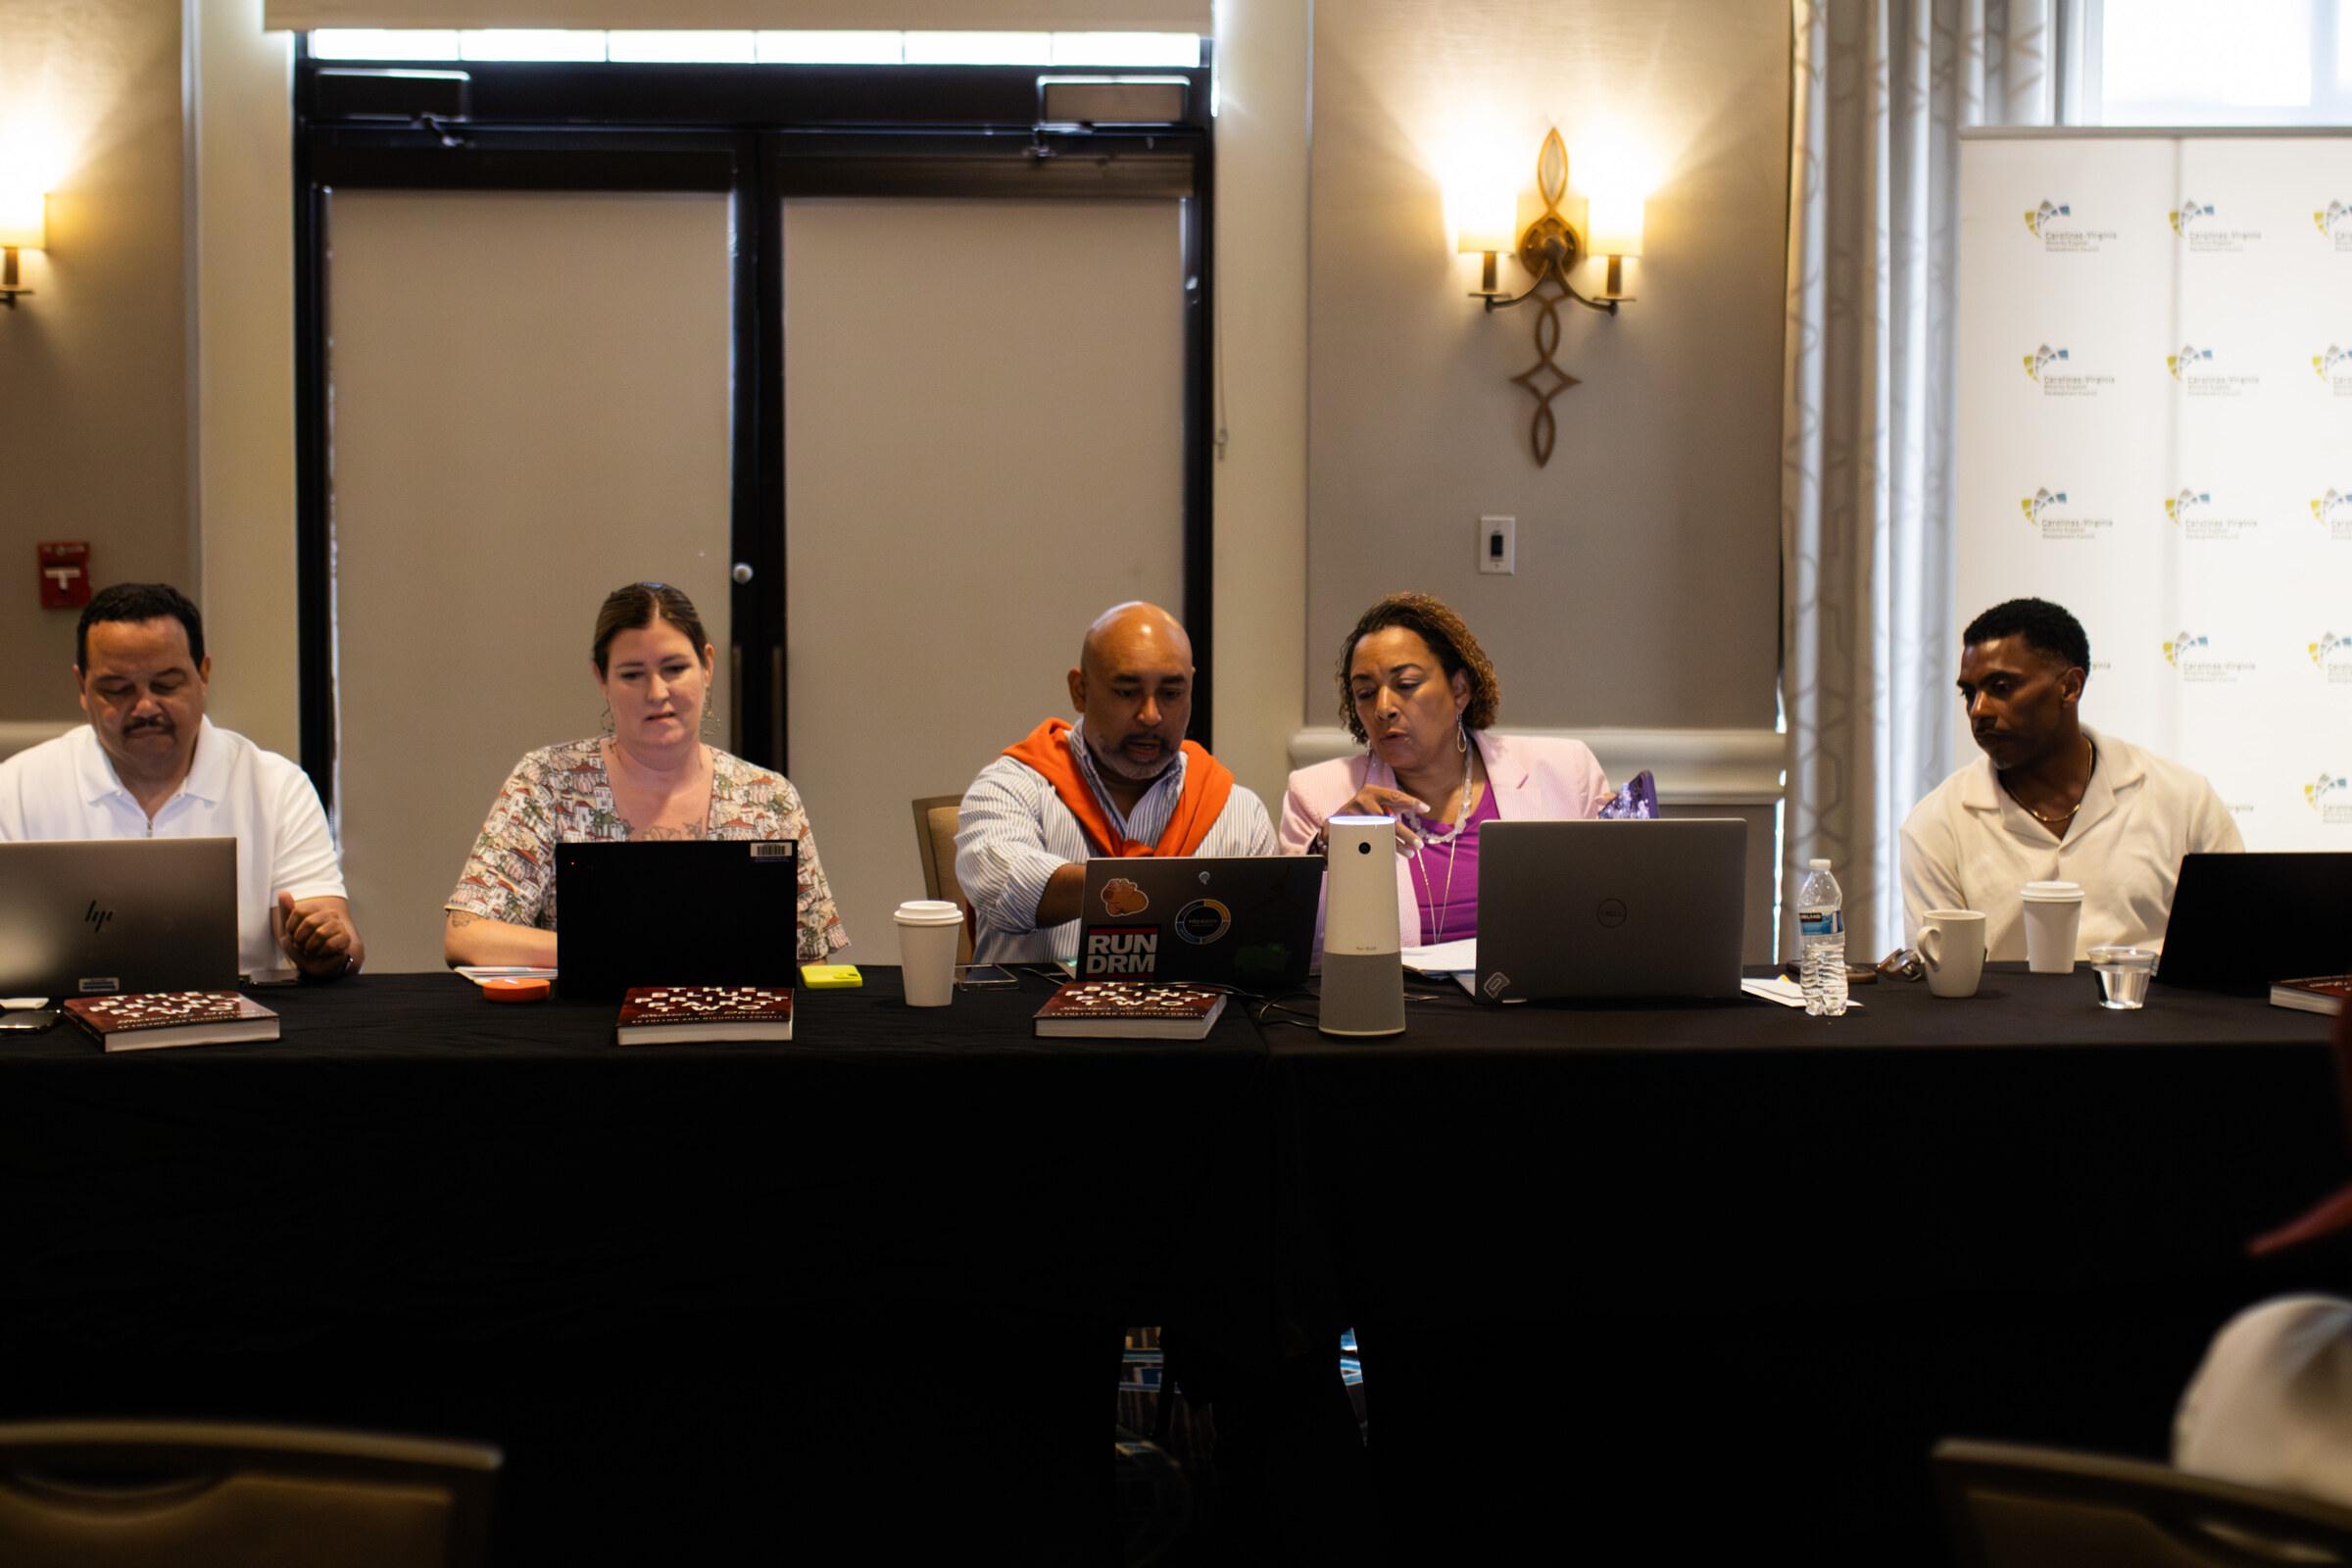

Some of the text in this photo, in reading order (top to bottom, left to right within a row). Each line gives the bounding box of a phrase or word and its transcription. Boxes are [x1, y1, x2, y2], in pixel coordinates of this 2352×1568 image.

[1088, 934, 1158, 955] RUN
[1086, 955, 1156, 974] DRM
[123, 1005, 233, 1018] TWO
